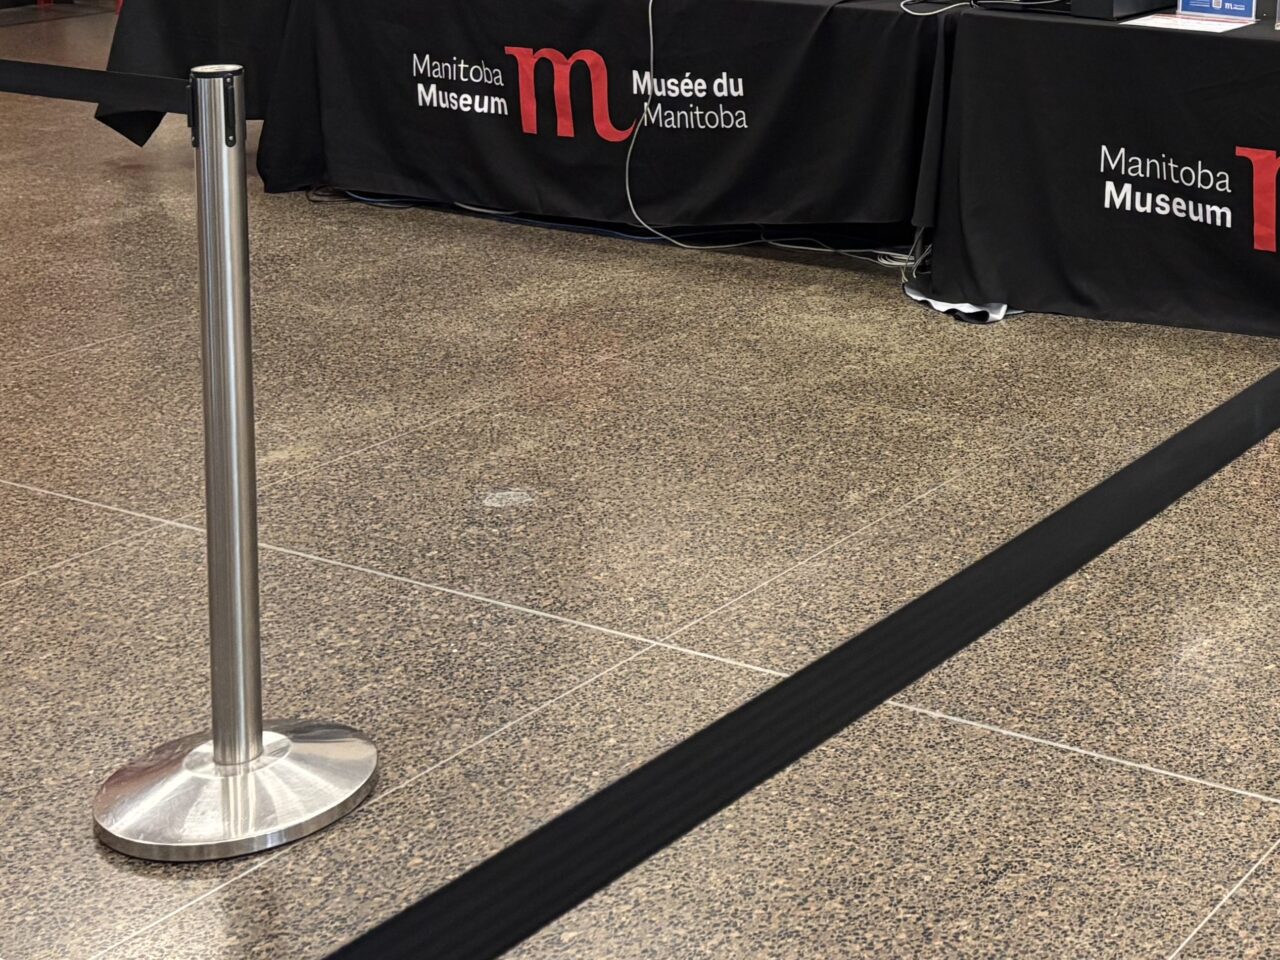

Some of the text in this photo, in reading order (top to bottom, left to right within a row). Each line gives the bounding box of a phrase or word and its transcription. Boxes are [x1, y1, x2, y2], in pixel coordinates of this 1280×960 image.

[412, 53, 506, 88] Manitoba
[631, 69, 744, 99] Musée du
[416, 82, 510, 117] Museum
[643, 102, 750, 130] Manitoba
[1099, 144, 1232, 194] Manitoba
[1102, 180, 1233, 229] Museum
